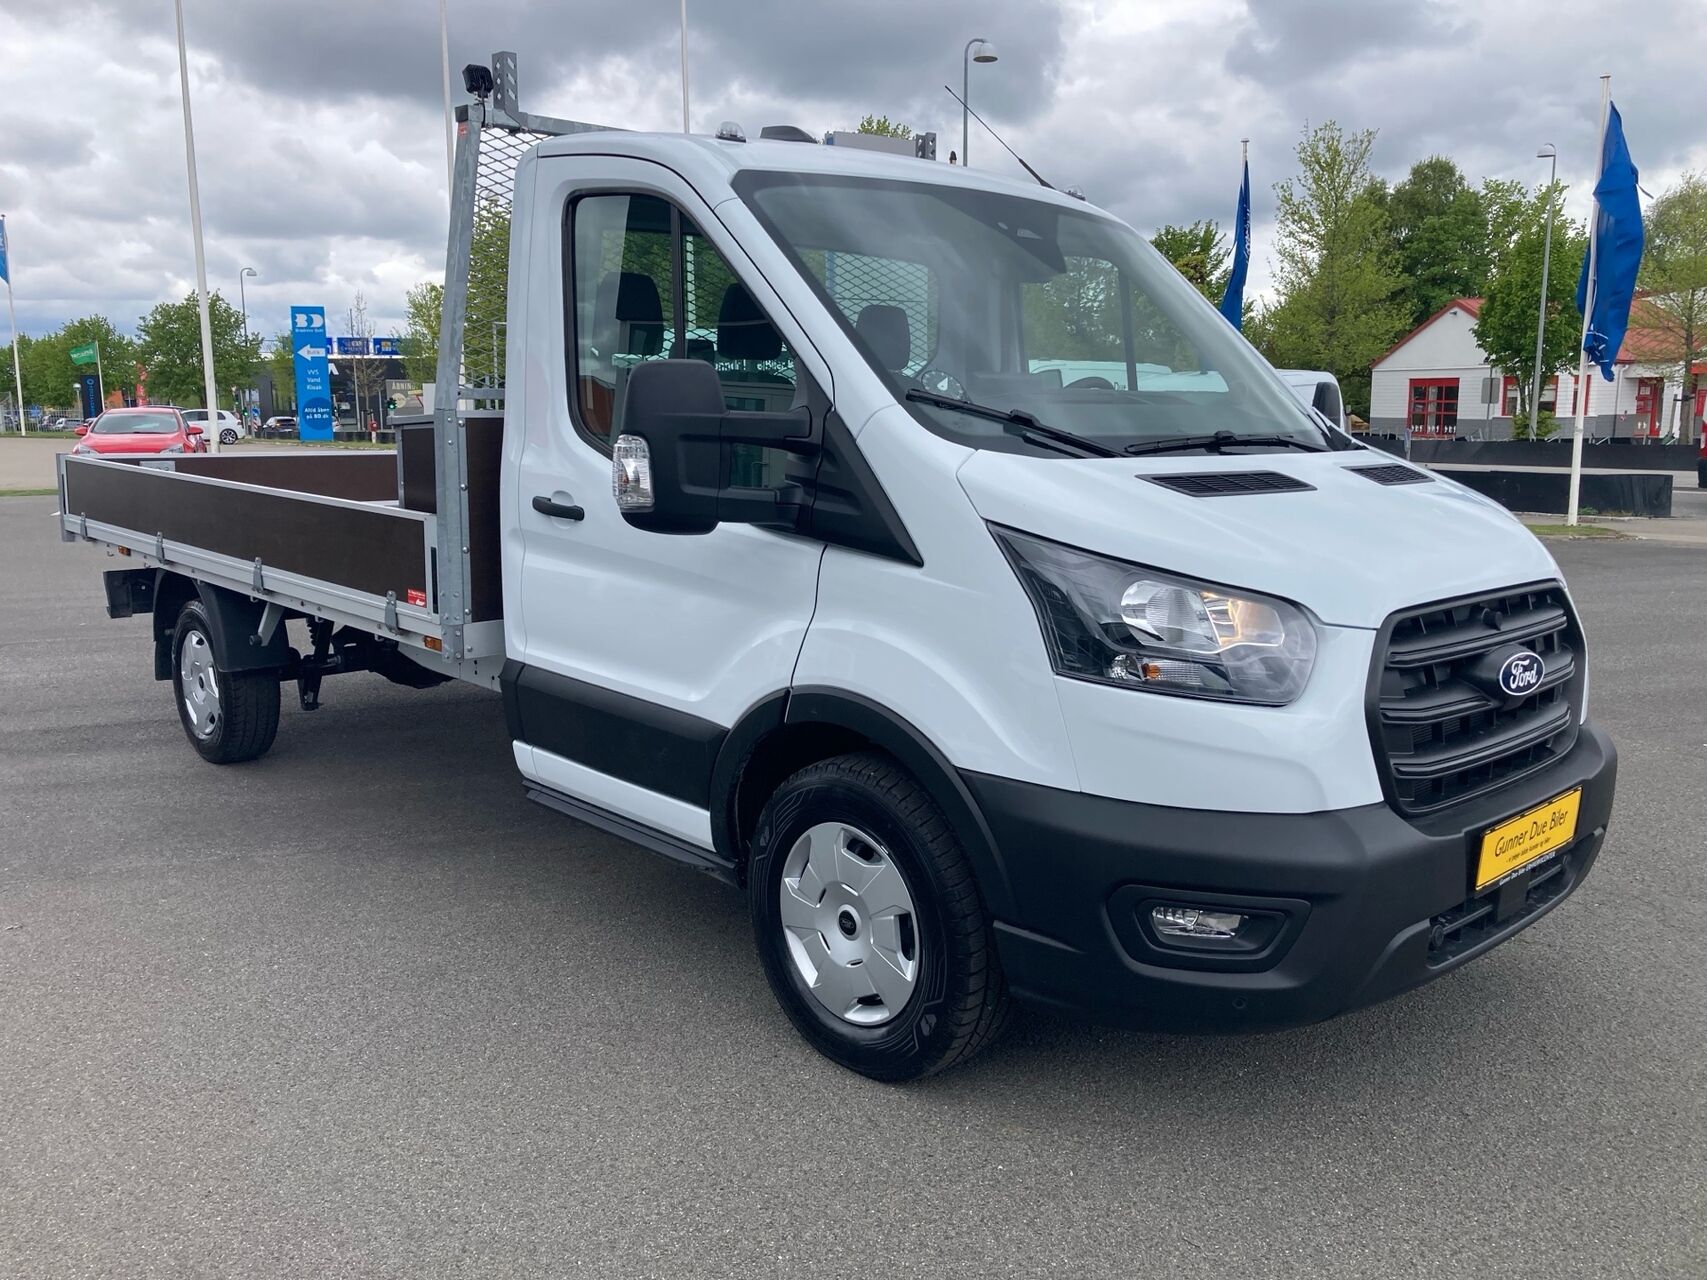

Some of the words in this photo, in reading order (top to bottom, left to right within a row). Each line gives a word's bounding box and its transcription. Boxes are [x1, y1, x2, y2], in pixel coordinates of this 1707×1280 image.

[296, 313, 324, 328] BD
[1509, 658, 1538, 690] Ford
[1495, 830, 1528, 857] Gunner
[1529, 820, 1548, 841] Due
[1549, 809, 1569, 831] Biler
